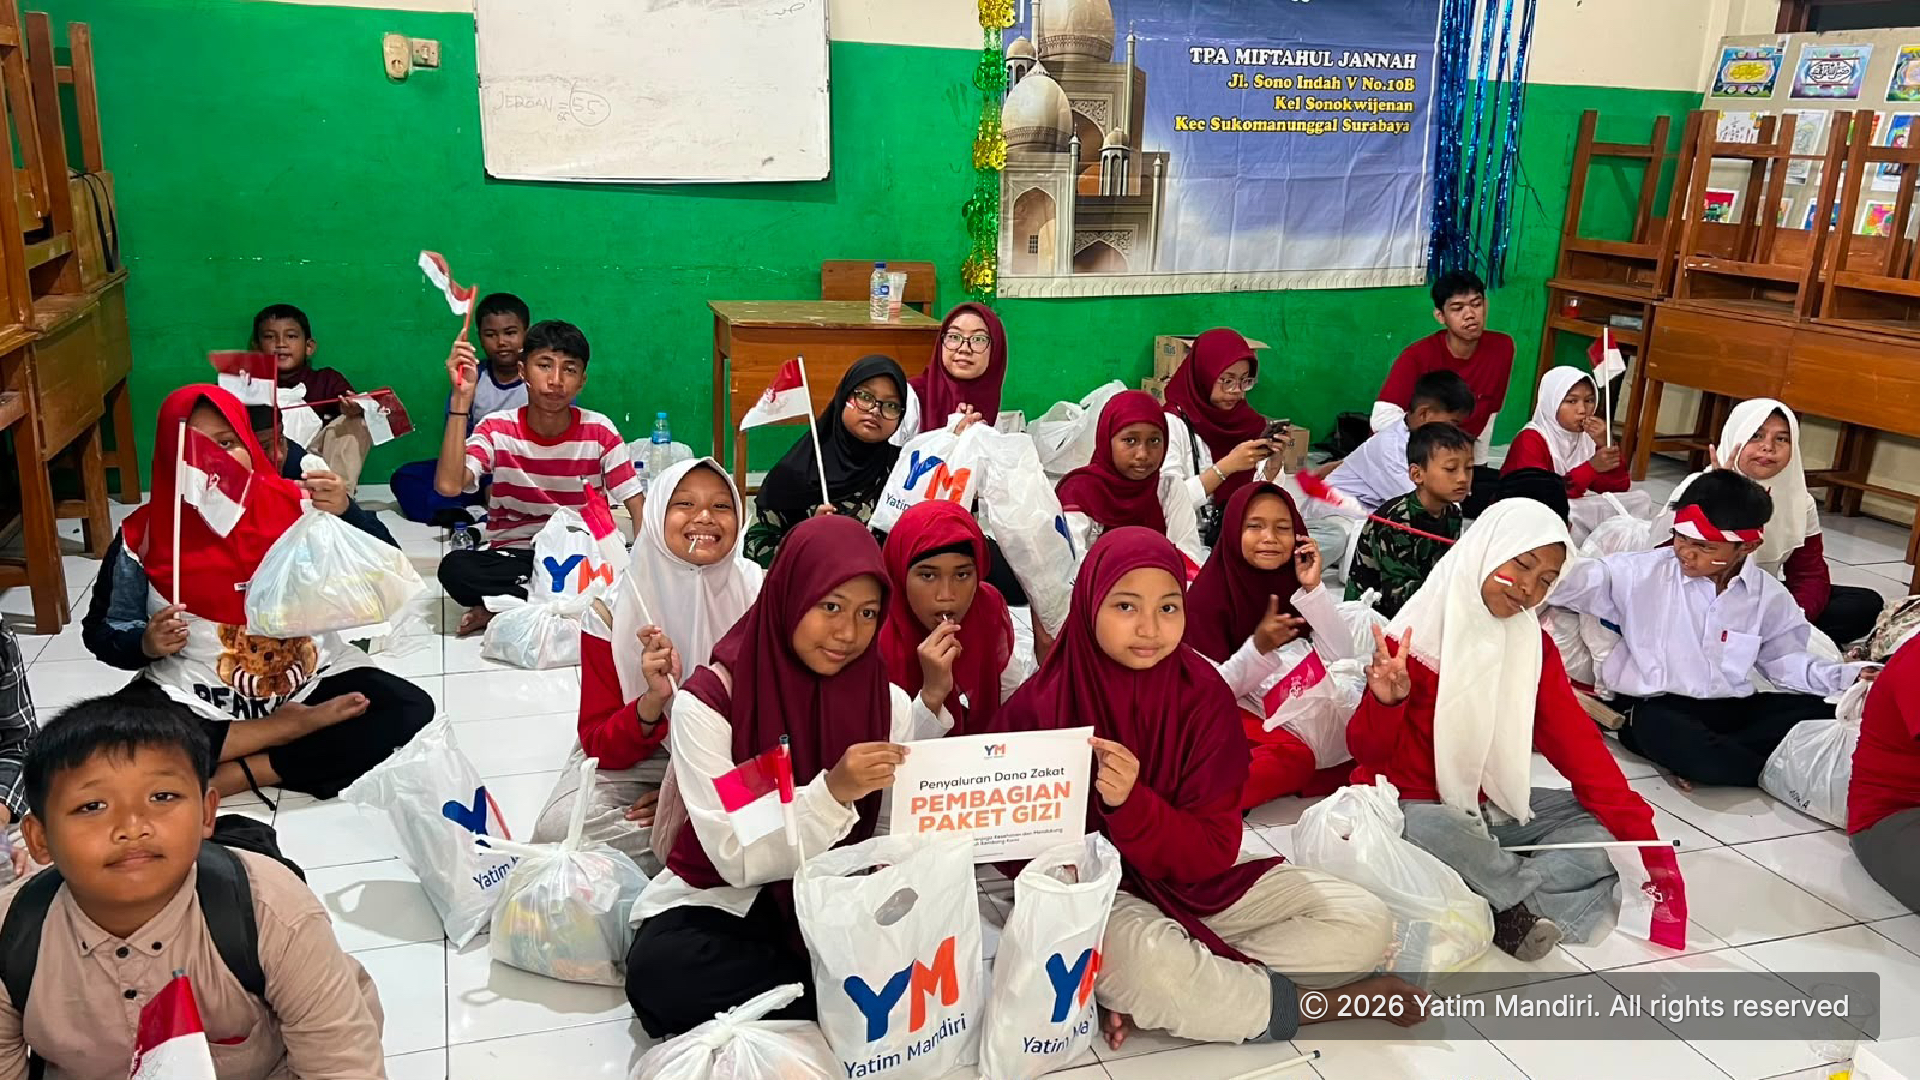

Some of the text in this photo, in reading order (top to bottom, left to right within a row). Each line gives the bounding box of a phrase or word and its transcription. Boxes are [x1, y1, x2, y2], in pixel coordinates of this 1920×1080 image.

[1190, 48, 1417, 69] TPA MIFTAHUL JANNAH
[1227, 74, 1415, 92] Jl. Sono Indah V No.10B
[1274, 96, 1413, 114] Kel Sonokwijenan
[1175, 116, 1410, 135] Kec Sukomanunggal Surabaya
[542, 554, 614, 594] YM
[984, 744, 1006, 756] YM
[919, 768, 1065, 791] Penyaluran Dana Zakat
[911, 781, 1071, 815] PEMBAGIAN
[918, 802, 1062, 833] PAKET GIZI
[844, 936, 959, 1043] YM
[844, 1013, 966, 1079] Yatim Mandiri
